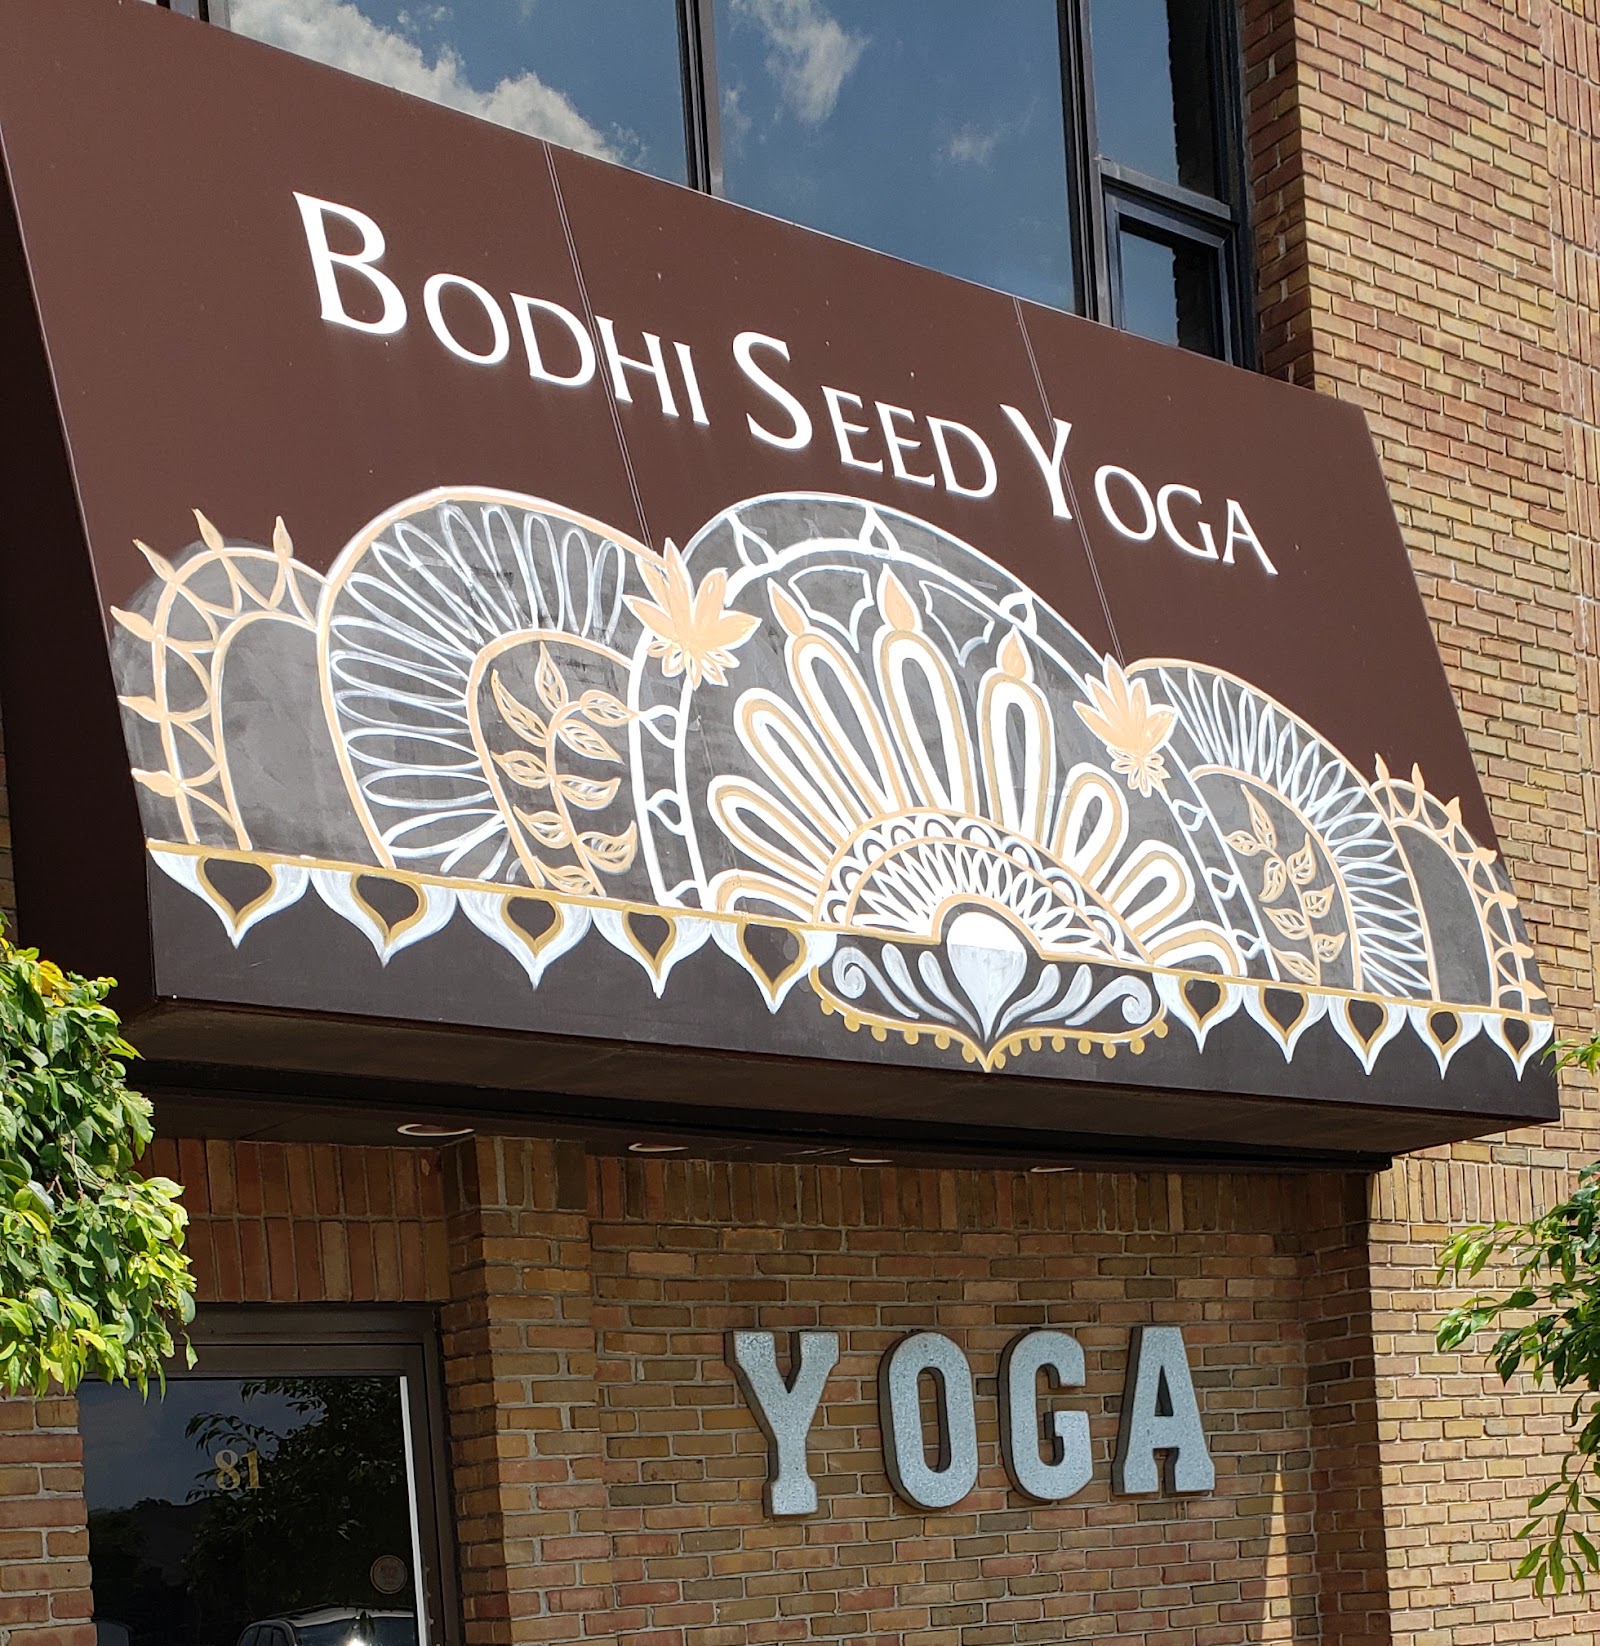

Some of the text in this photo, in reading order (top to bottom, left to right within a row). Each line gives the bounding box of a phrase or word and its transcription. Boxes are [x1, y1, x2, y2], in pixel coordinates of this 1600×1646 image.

[292, 191, 1279, 576] BODHI SEED YOGA
[214, 1449, 264, 1491] 81
[724, 1325, 1216, 1515] YOGA
